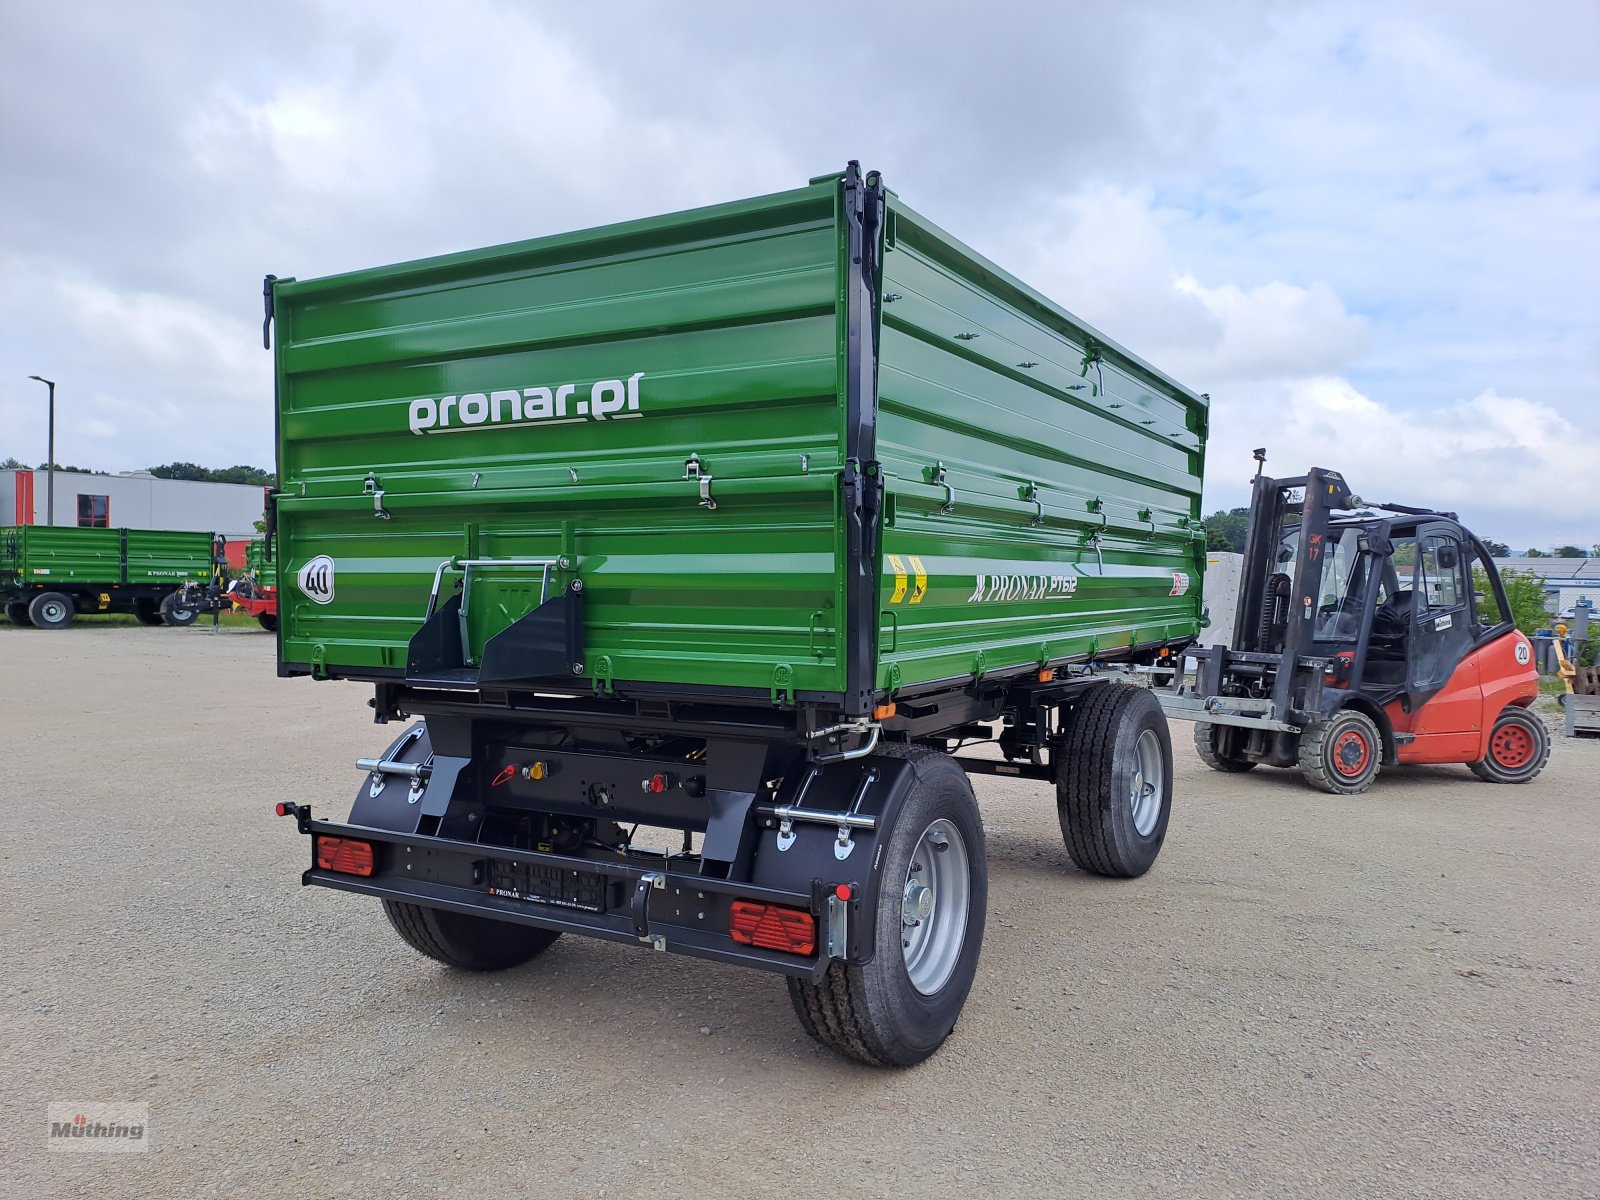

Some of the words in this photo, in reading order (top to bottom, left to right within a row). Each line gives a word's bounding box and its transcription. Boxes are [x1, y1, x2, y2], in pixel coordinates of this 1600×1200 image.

[408, 372, 645, 436] pronar.pl
[1309, 547, 1320, 560] 17
[305, 564, 329, 595] 40
[984, 575, 1048, 602] PRONAR
[1048, 575, 1078, 593] PT612
[1518, 646, 1528, 660] 20
[495, 888, 520, 899] PRONAR
